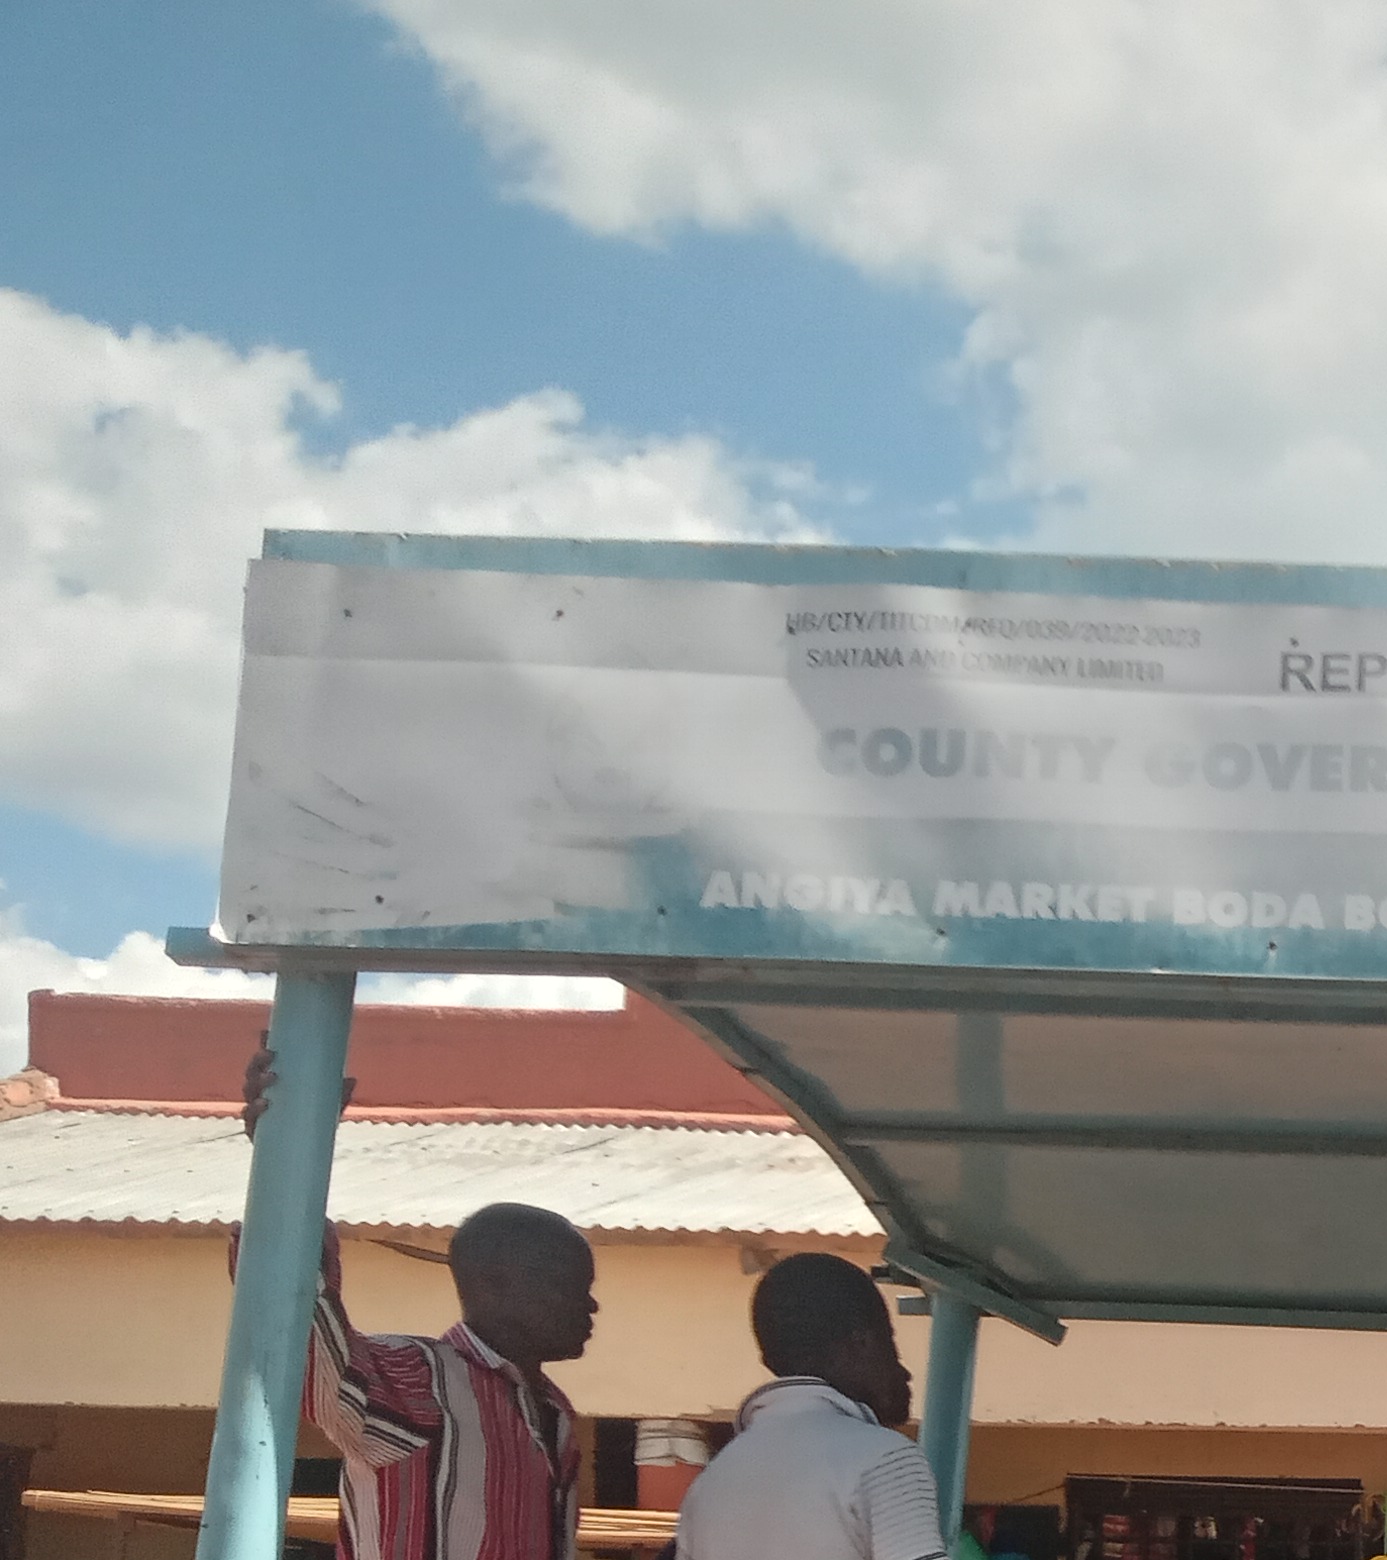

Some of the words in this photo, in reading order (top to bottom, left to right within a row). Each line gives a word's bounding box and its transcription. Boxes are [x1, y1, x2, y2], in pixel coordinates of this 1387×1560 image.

[806, 648, 904, 669] SANTANA
[908, 648, 957, 672] AND
[961, 653, 1067, 676] COMPANY
[1077, 657, 1164, 683] LIMITED
[815, 728, 1116, 783] COUNTY
[701, 869, 917, 917] ANGIYA
[932, 880, 1156, 922] MARKET
[1173, 890, 1324, 928] BODA
